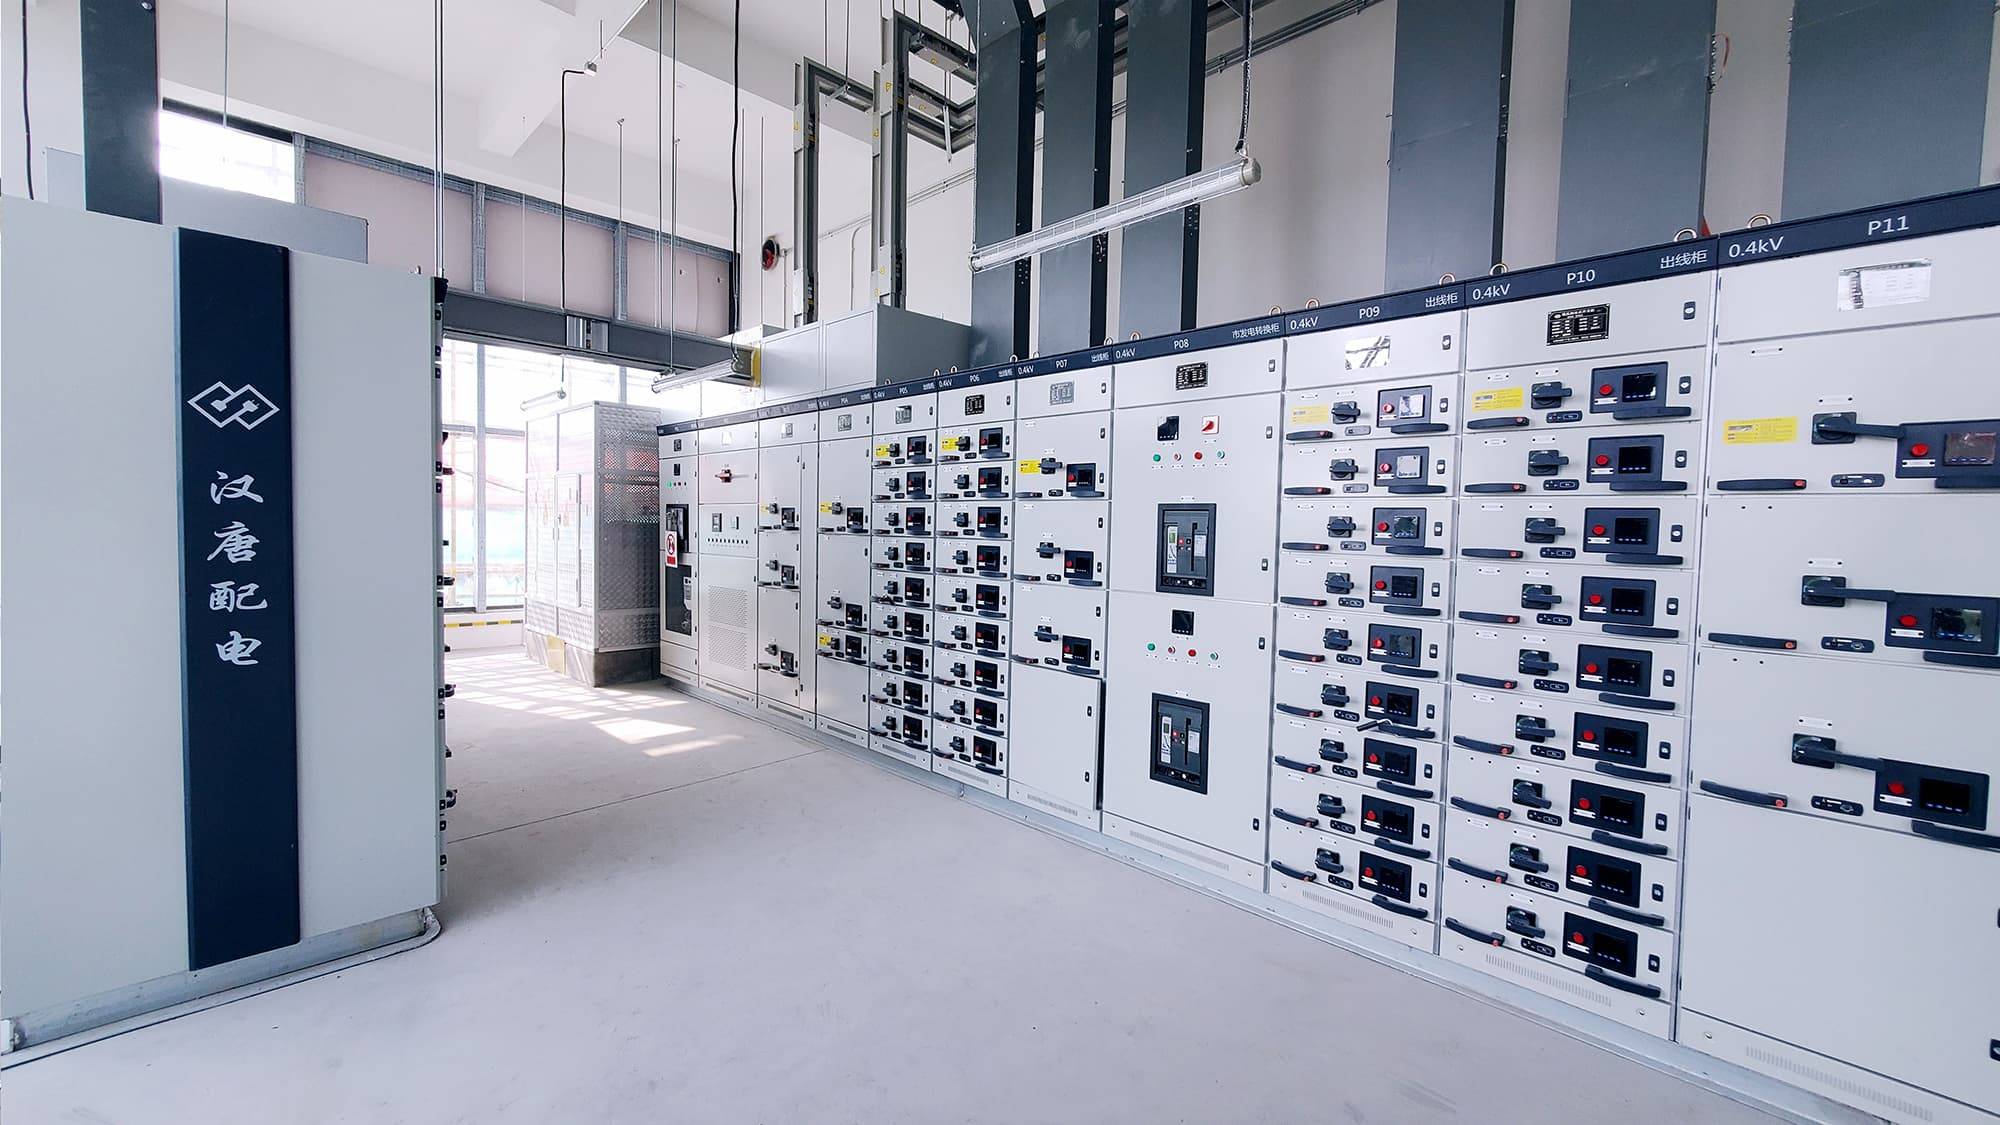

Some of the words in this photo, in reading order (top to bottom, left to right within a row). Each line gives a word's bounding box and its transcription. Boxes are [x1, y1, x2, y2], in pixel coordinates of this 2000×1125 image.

[1868, 215, 1909, 235] P11
[1728, 236, 1784, 258] 0.4kV
[1660, 250, 1708, 269] 出线柜
[1567, 269, 1596, 285] P10
[1472, 284, 1510, 301] 0.4kV
[1425, 293, 1459, 308] 出线柜
[1359, 306, 1380, 319] P09
[1290, 317, 1318, 330] 0.4kV
[1174, 339, 1189, 349] P08
[1115, 348, 1136, 360] 0.4kV
[1018, 365, 1034, 375] 0.4kV
[1056, 360, 1068, 369] P07
[206, 470, 268, 666] 汉唐配电
